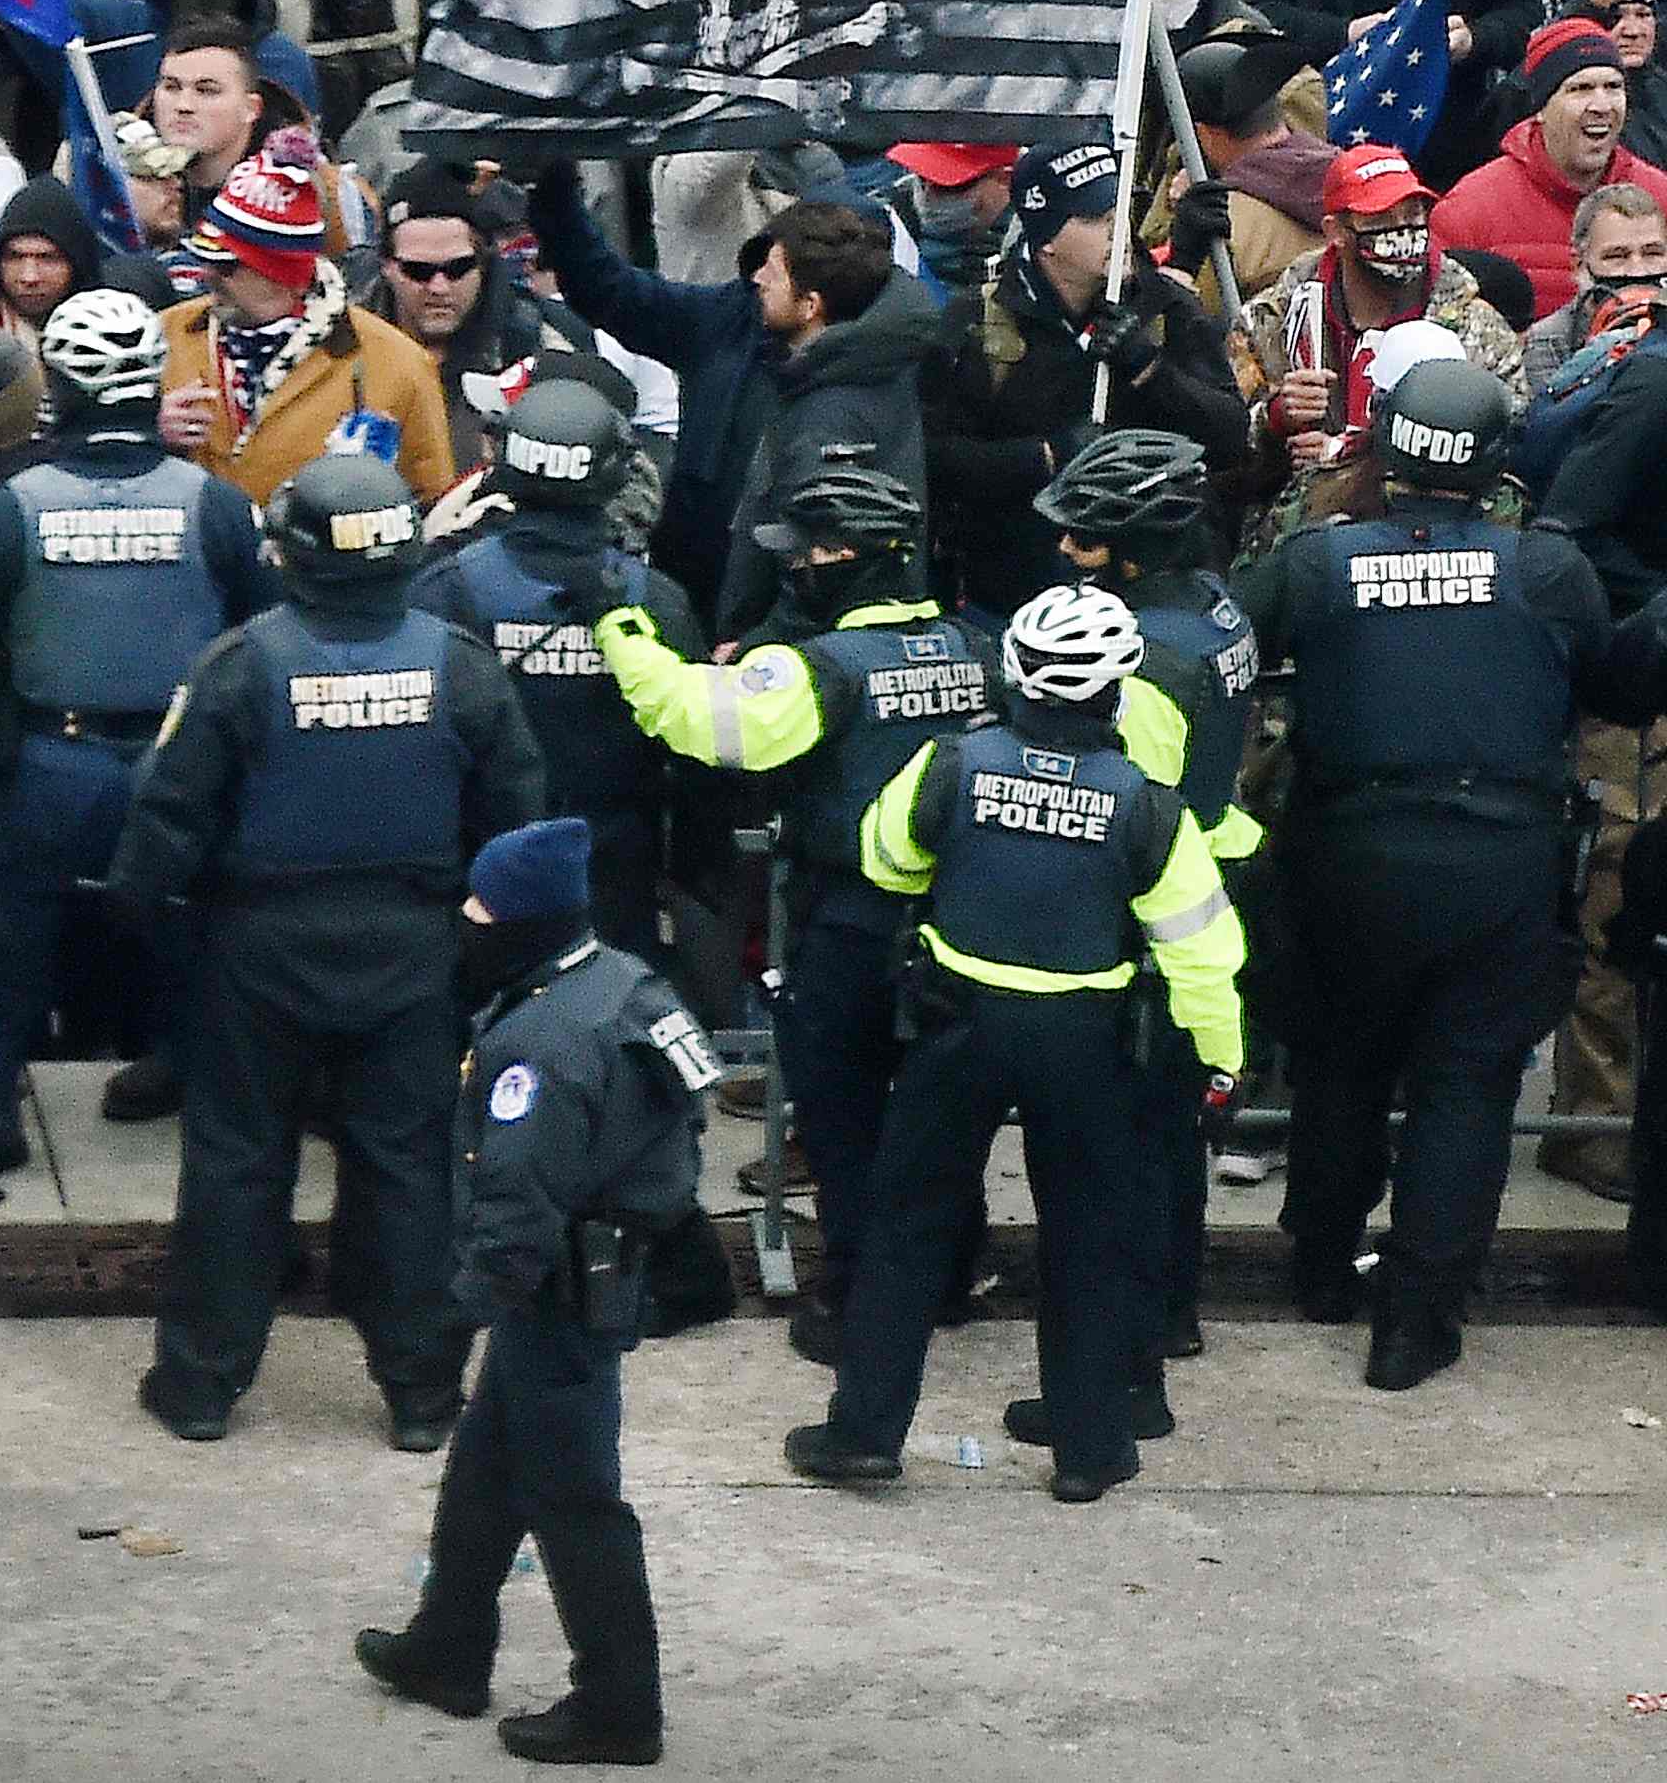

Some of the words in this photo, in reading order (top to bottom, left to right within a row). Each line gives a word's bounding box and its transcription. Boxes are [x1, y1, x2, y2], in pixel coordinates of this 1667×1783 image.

[1024, 184, 1050, 211] 45
[1391, 412, 1475, 465] MPDC
[43, 534, 182, 564] POLICE
[1350, 551, 1496, 584] METROPOLITAN
[1356, 578, 1493, 609] POLICE
[497, 649, 611, 677] POLIC
[868, 663, 987, 698] METROPOLITAN
[293, 697, 432, 731] POLICE
[875, 687, 989, 720] POLICE
[972, 770, 1117, 819] METROPOLITAN
[974, 797, 1108, 843] POLICE
